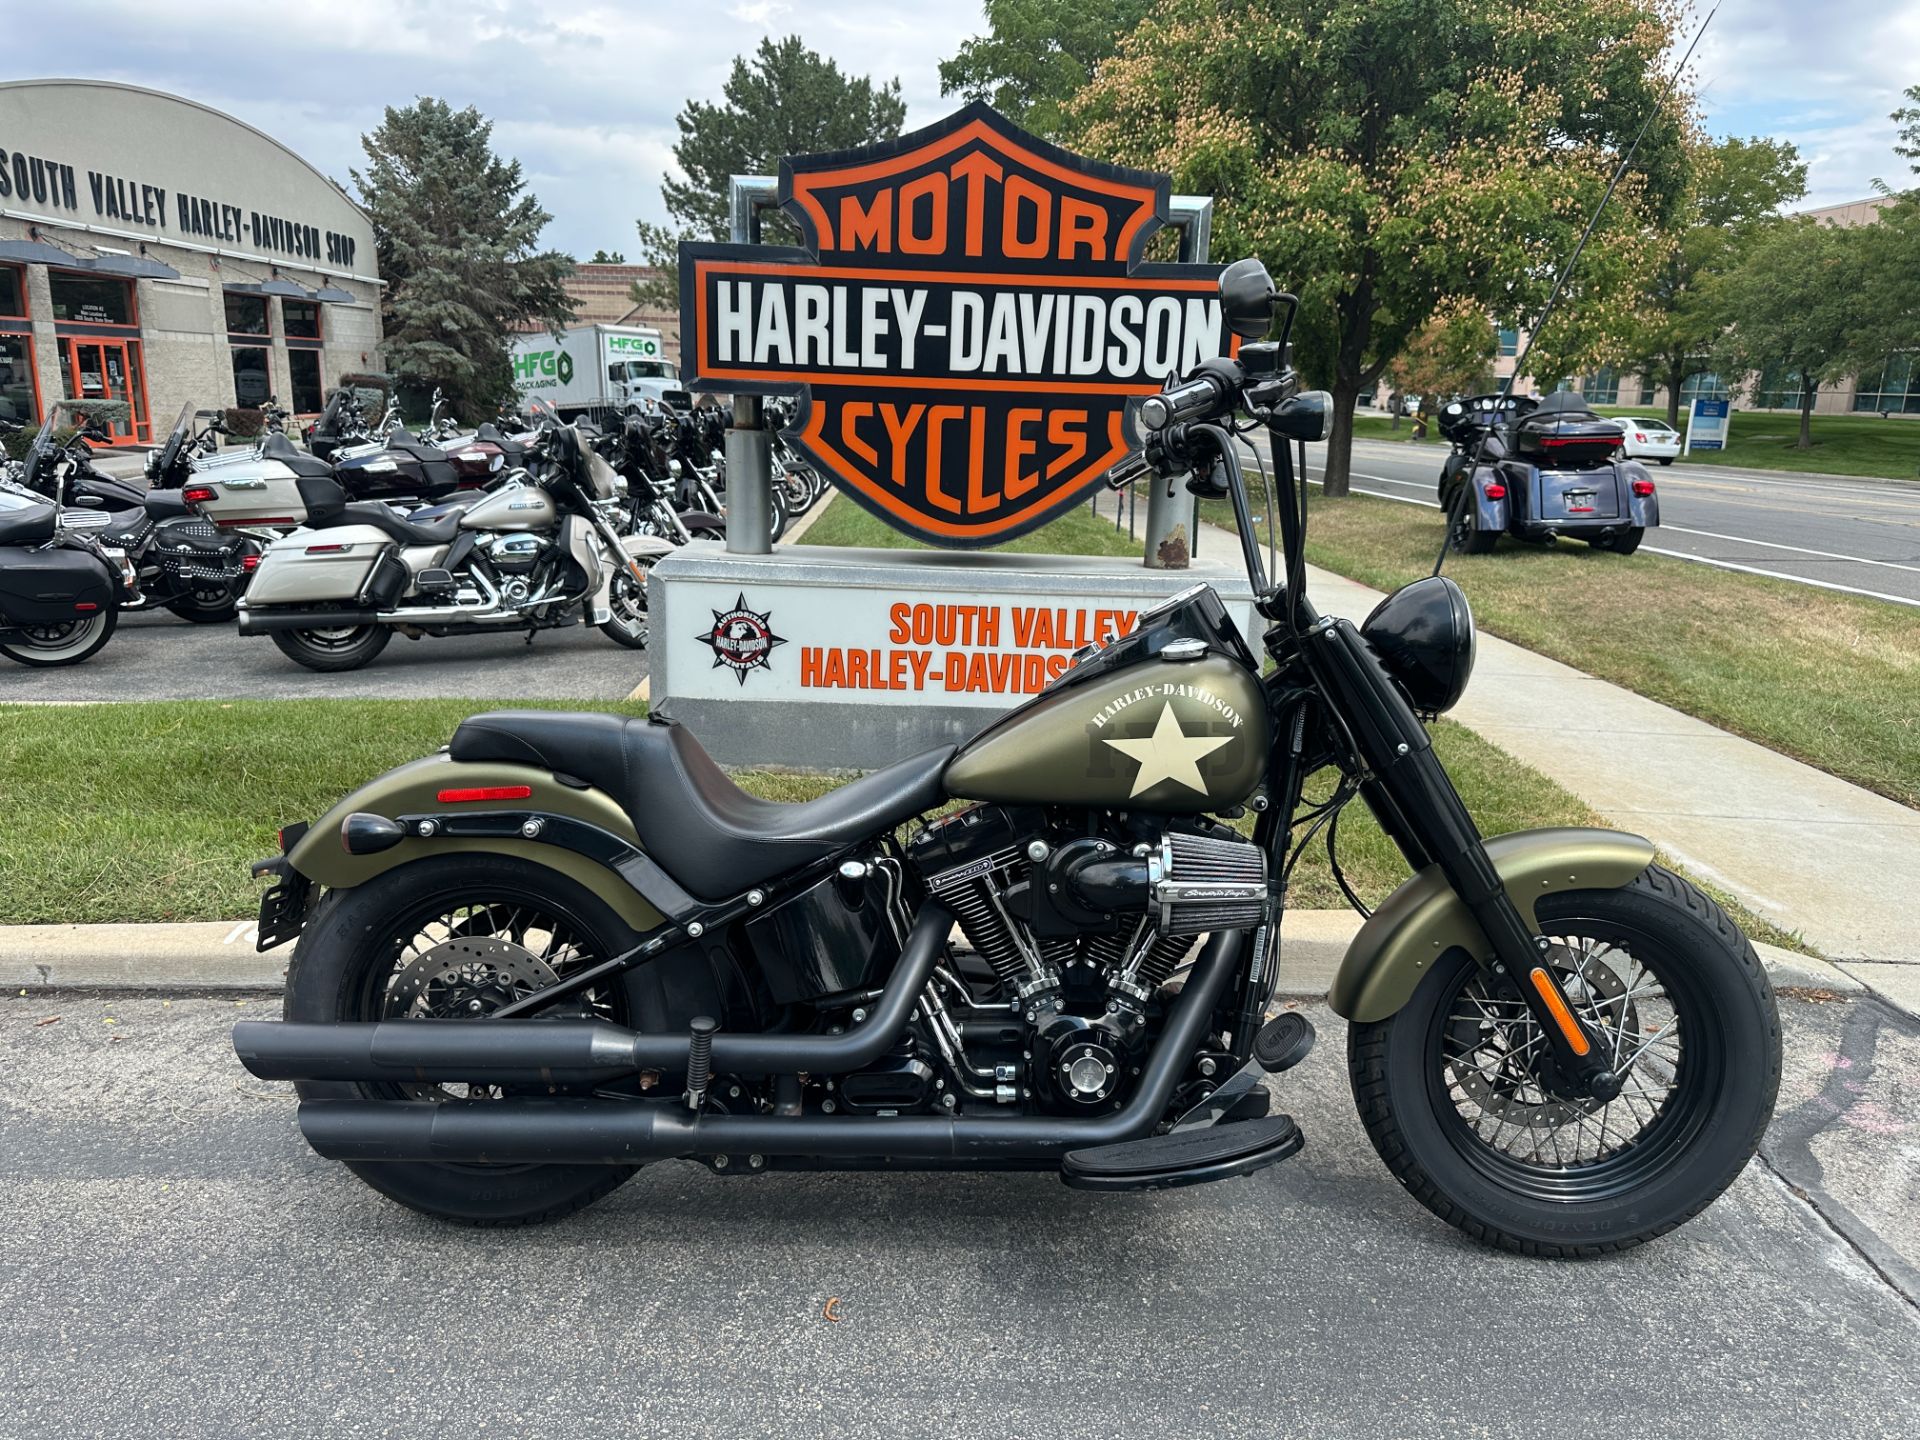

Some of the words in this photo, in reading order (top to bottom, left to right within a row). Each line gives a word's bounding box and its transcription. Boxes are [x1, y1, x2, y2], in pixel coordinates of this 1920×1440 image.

[0, 148, 77, 210] SOUTH
[88, 171, 166, 227] VALLEY
[177, 193, 321, 259] HARLEY-DAVIDSON
[326, 231, 356, 266] SHOP
[840, 150, 1109, 261] MOTOR
[609, 337, 644, 350] HFG
[717, 280, 1223, 379] HARLEY-DAVIDSON
[514, 351, 557, 379] HFG
[515, 379, 557, 391] PACKAGING
[841, 401, 1087, 515] CYCLES
[717, 611, 767, 629] AUTHORIZED
[889, 603, 1001, 646] SOUTH
[1011, 607, 1138, 650] VALLEY
[715, 635, 768, 652] HARLEY-DAVIDSON
[719, 654, 764, 669] RENTALS
[801, 647, 1078, 694] HARLEY-DAVIDS
[1091, 683, 1242, 728] HARLEY-DAVIDSON
